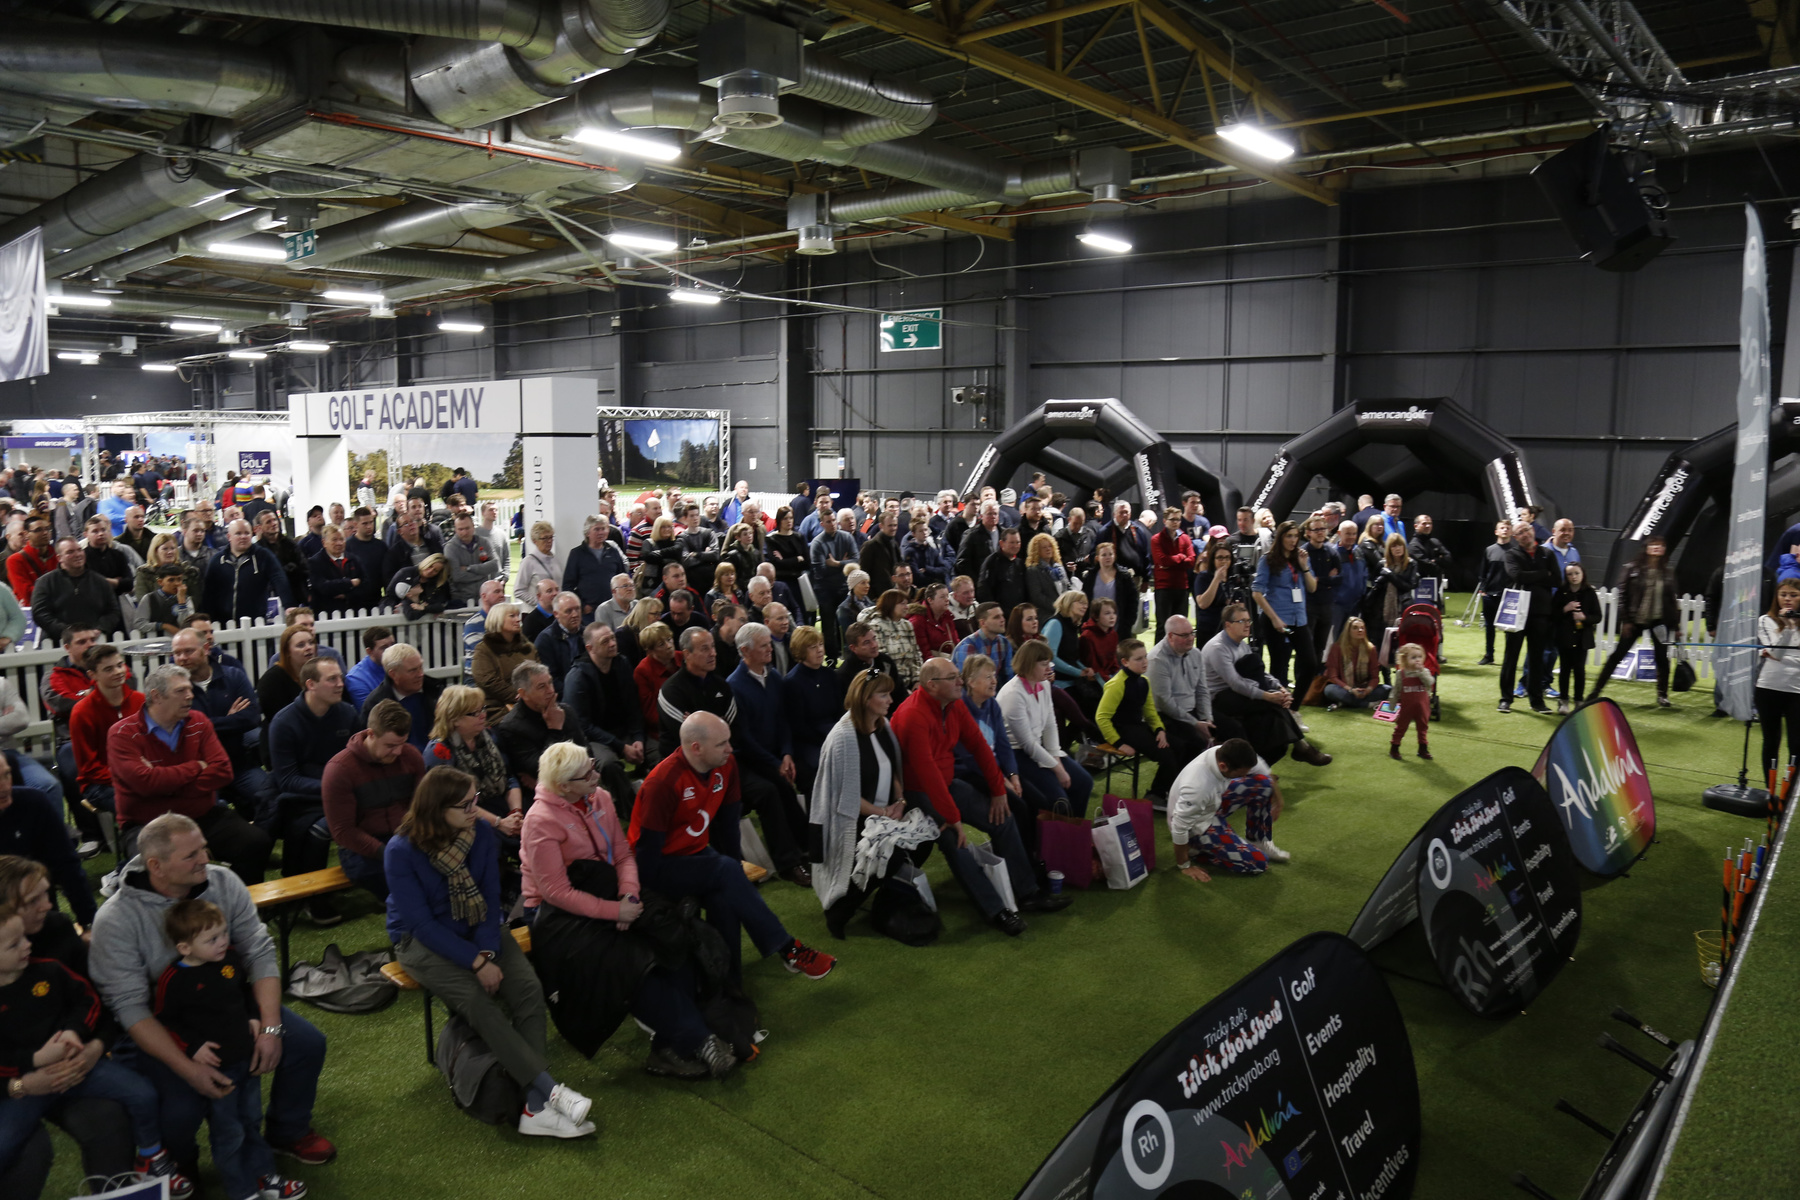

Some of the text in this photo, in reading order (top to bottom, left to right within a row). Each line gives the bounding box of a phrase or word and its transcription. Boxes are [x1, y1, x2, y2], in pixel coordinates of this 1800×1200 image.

[902, 324, 920, 333] EXIT
[329, 387, 485, 430] GOLF ACADEMY
[1361, 405, 1427, 421] americangolf
[241, 459, 269, 469] GOLF
[1251, 457, 1288, 513] americangolf
[1643, 468, 1690, 536] americangolf
[1502, 786, 1516, 805] Golf
[1512, 819, 1532, 839] Events
[1524, 843, 1552, 873] Hospitality
[1536, 880, 1555, 905] Travel
[1550, 908, 1578, 940] Incentives
[1291, 967, 1317, 1002] Golf
[1453, 936, 1497, 1013] Rh
[1203, 1006, 1248, 1049] Tricky Rob's
[1305, 1012, 1343, 1056] Events
[1176, 1055, 1222, 1100] Trick
[1193, 1047, 1281, 1126] www.trickyrob.org
[1322, 1042, 1377, 1108] Hospitality
[1137, 1129, 1159, 1159] Rh
[1341, 1110, 1375, 1159] Travel
